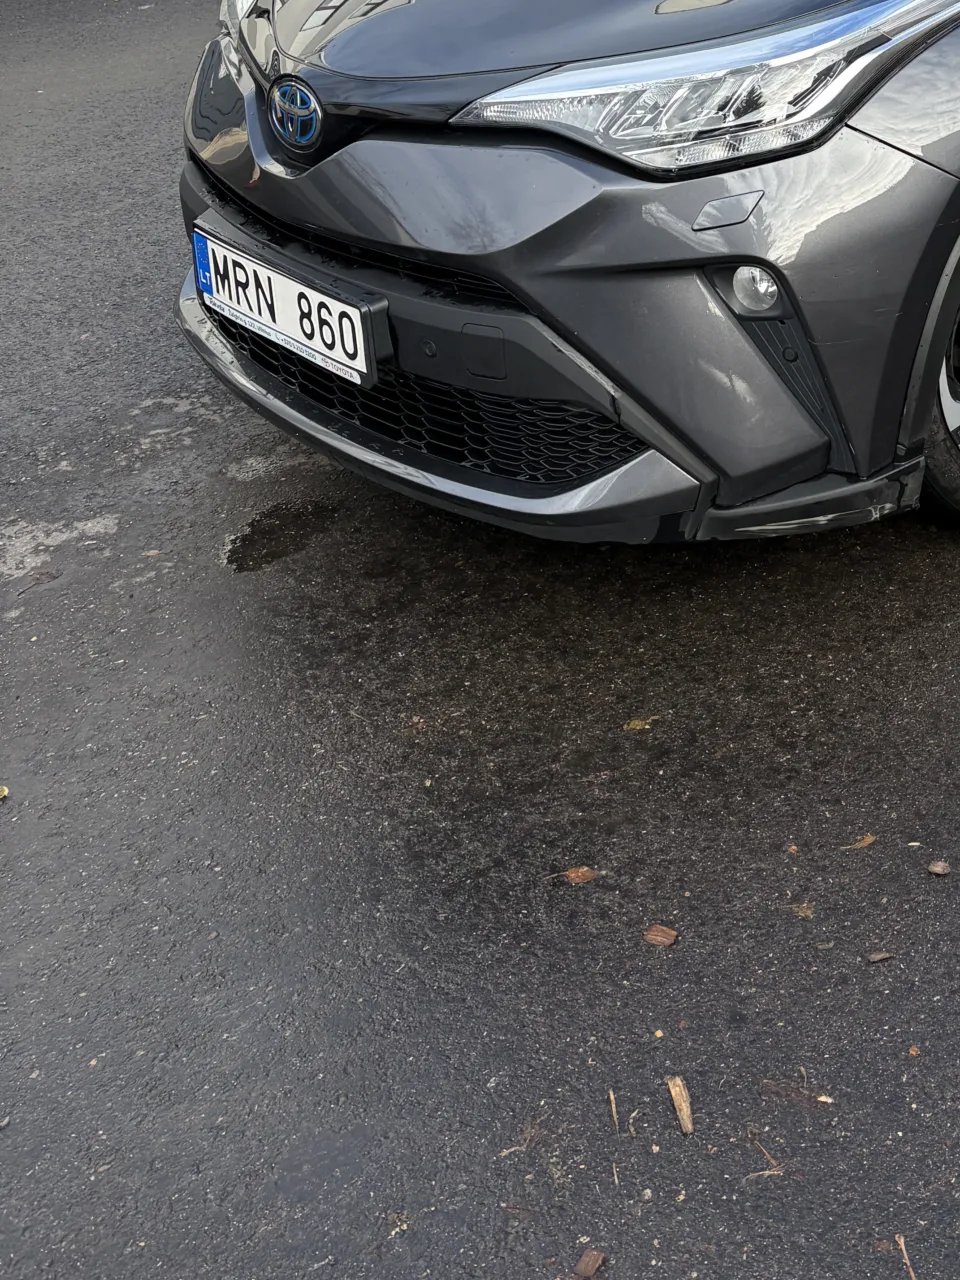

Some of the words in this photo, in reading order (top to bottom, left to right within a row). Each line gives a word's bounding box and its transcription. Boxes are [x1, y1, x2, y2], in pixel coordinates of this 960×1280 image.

[199, 268, 210, 284] LT
[210, 247, 276, 325] MRN
[297, 291, 358, 361] 860
[330, 361, 355, 380] TOYOTA
